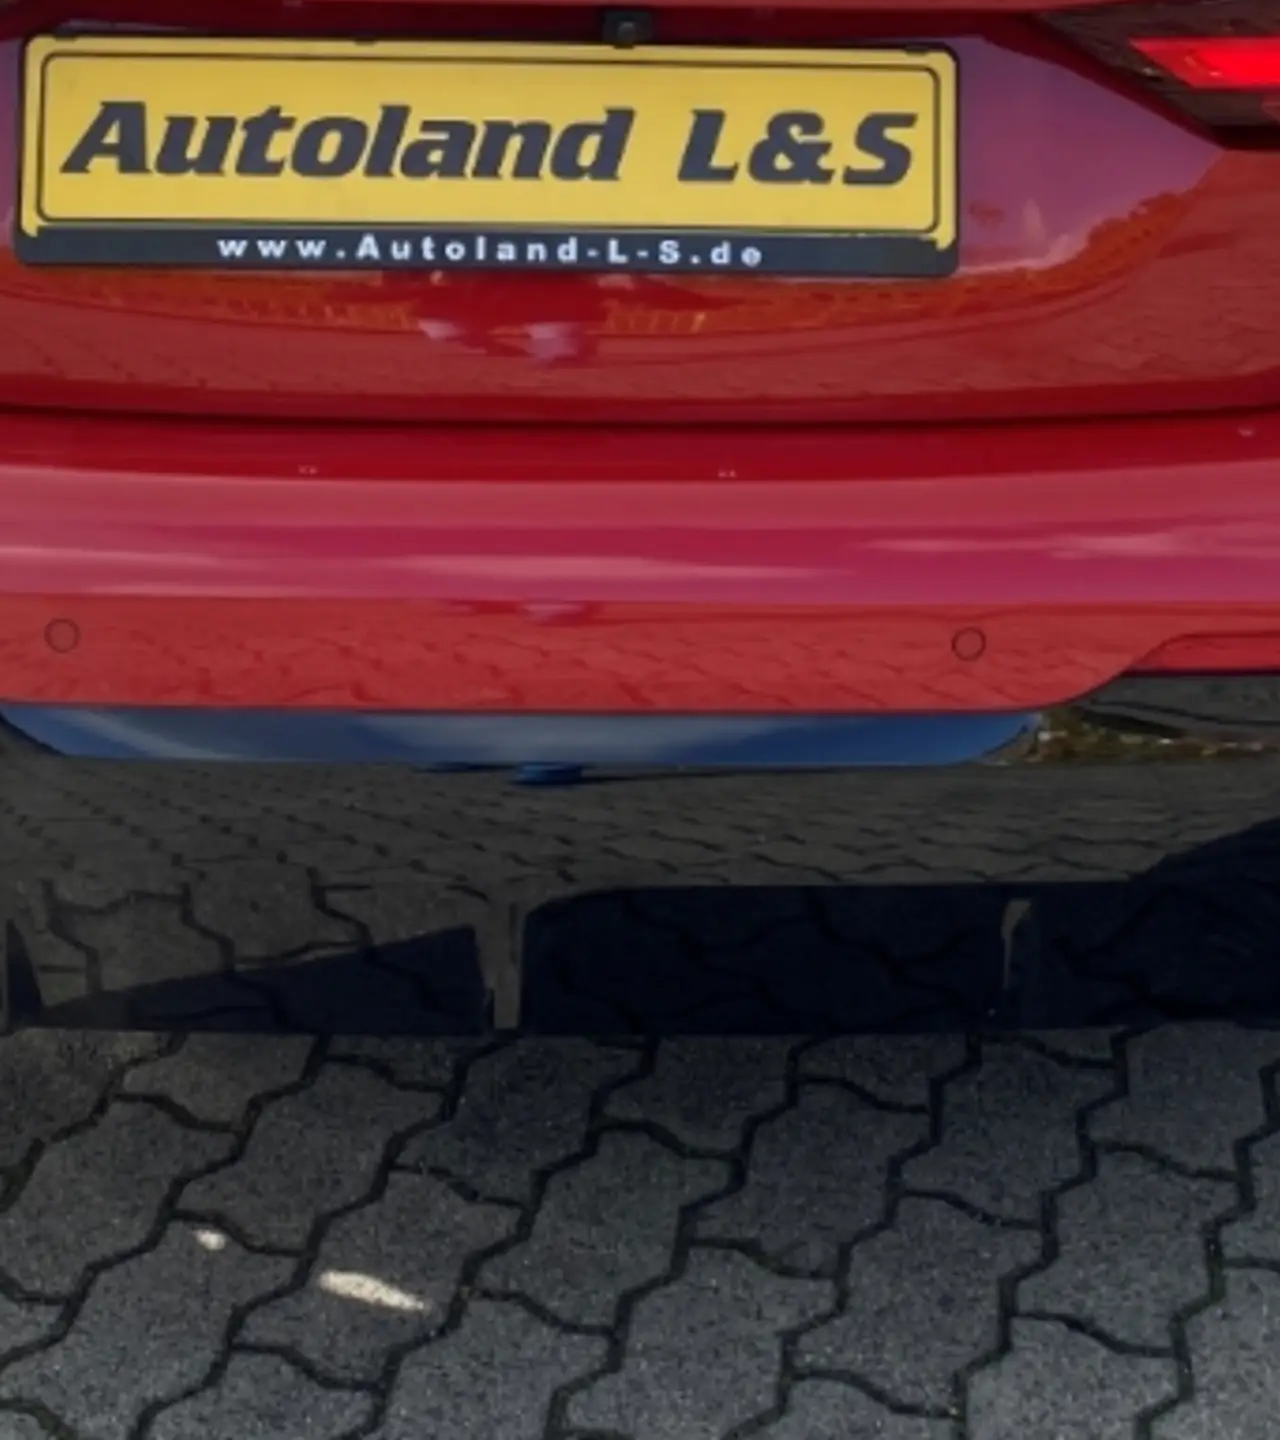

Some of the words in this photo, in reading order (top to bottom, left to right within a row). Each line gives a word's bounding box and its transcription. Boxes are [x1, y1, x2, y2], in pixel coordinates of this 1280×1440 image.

[59, 100, 636, 182] Autoland
[676, 109, 918, 185] L&S
[216, 234, 763, 267] www.Autoland-L-S.de
